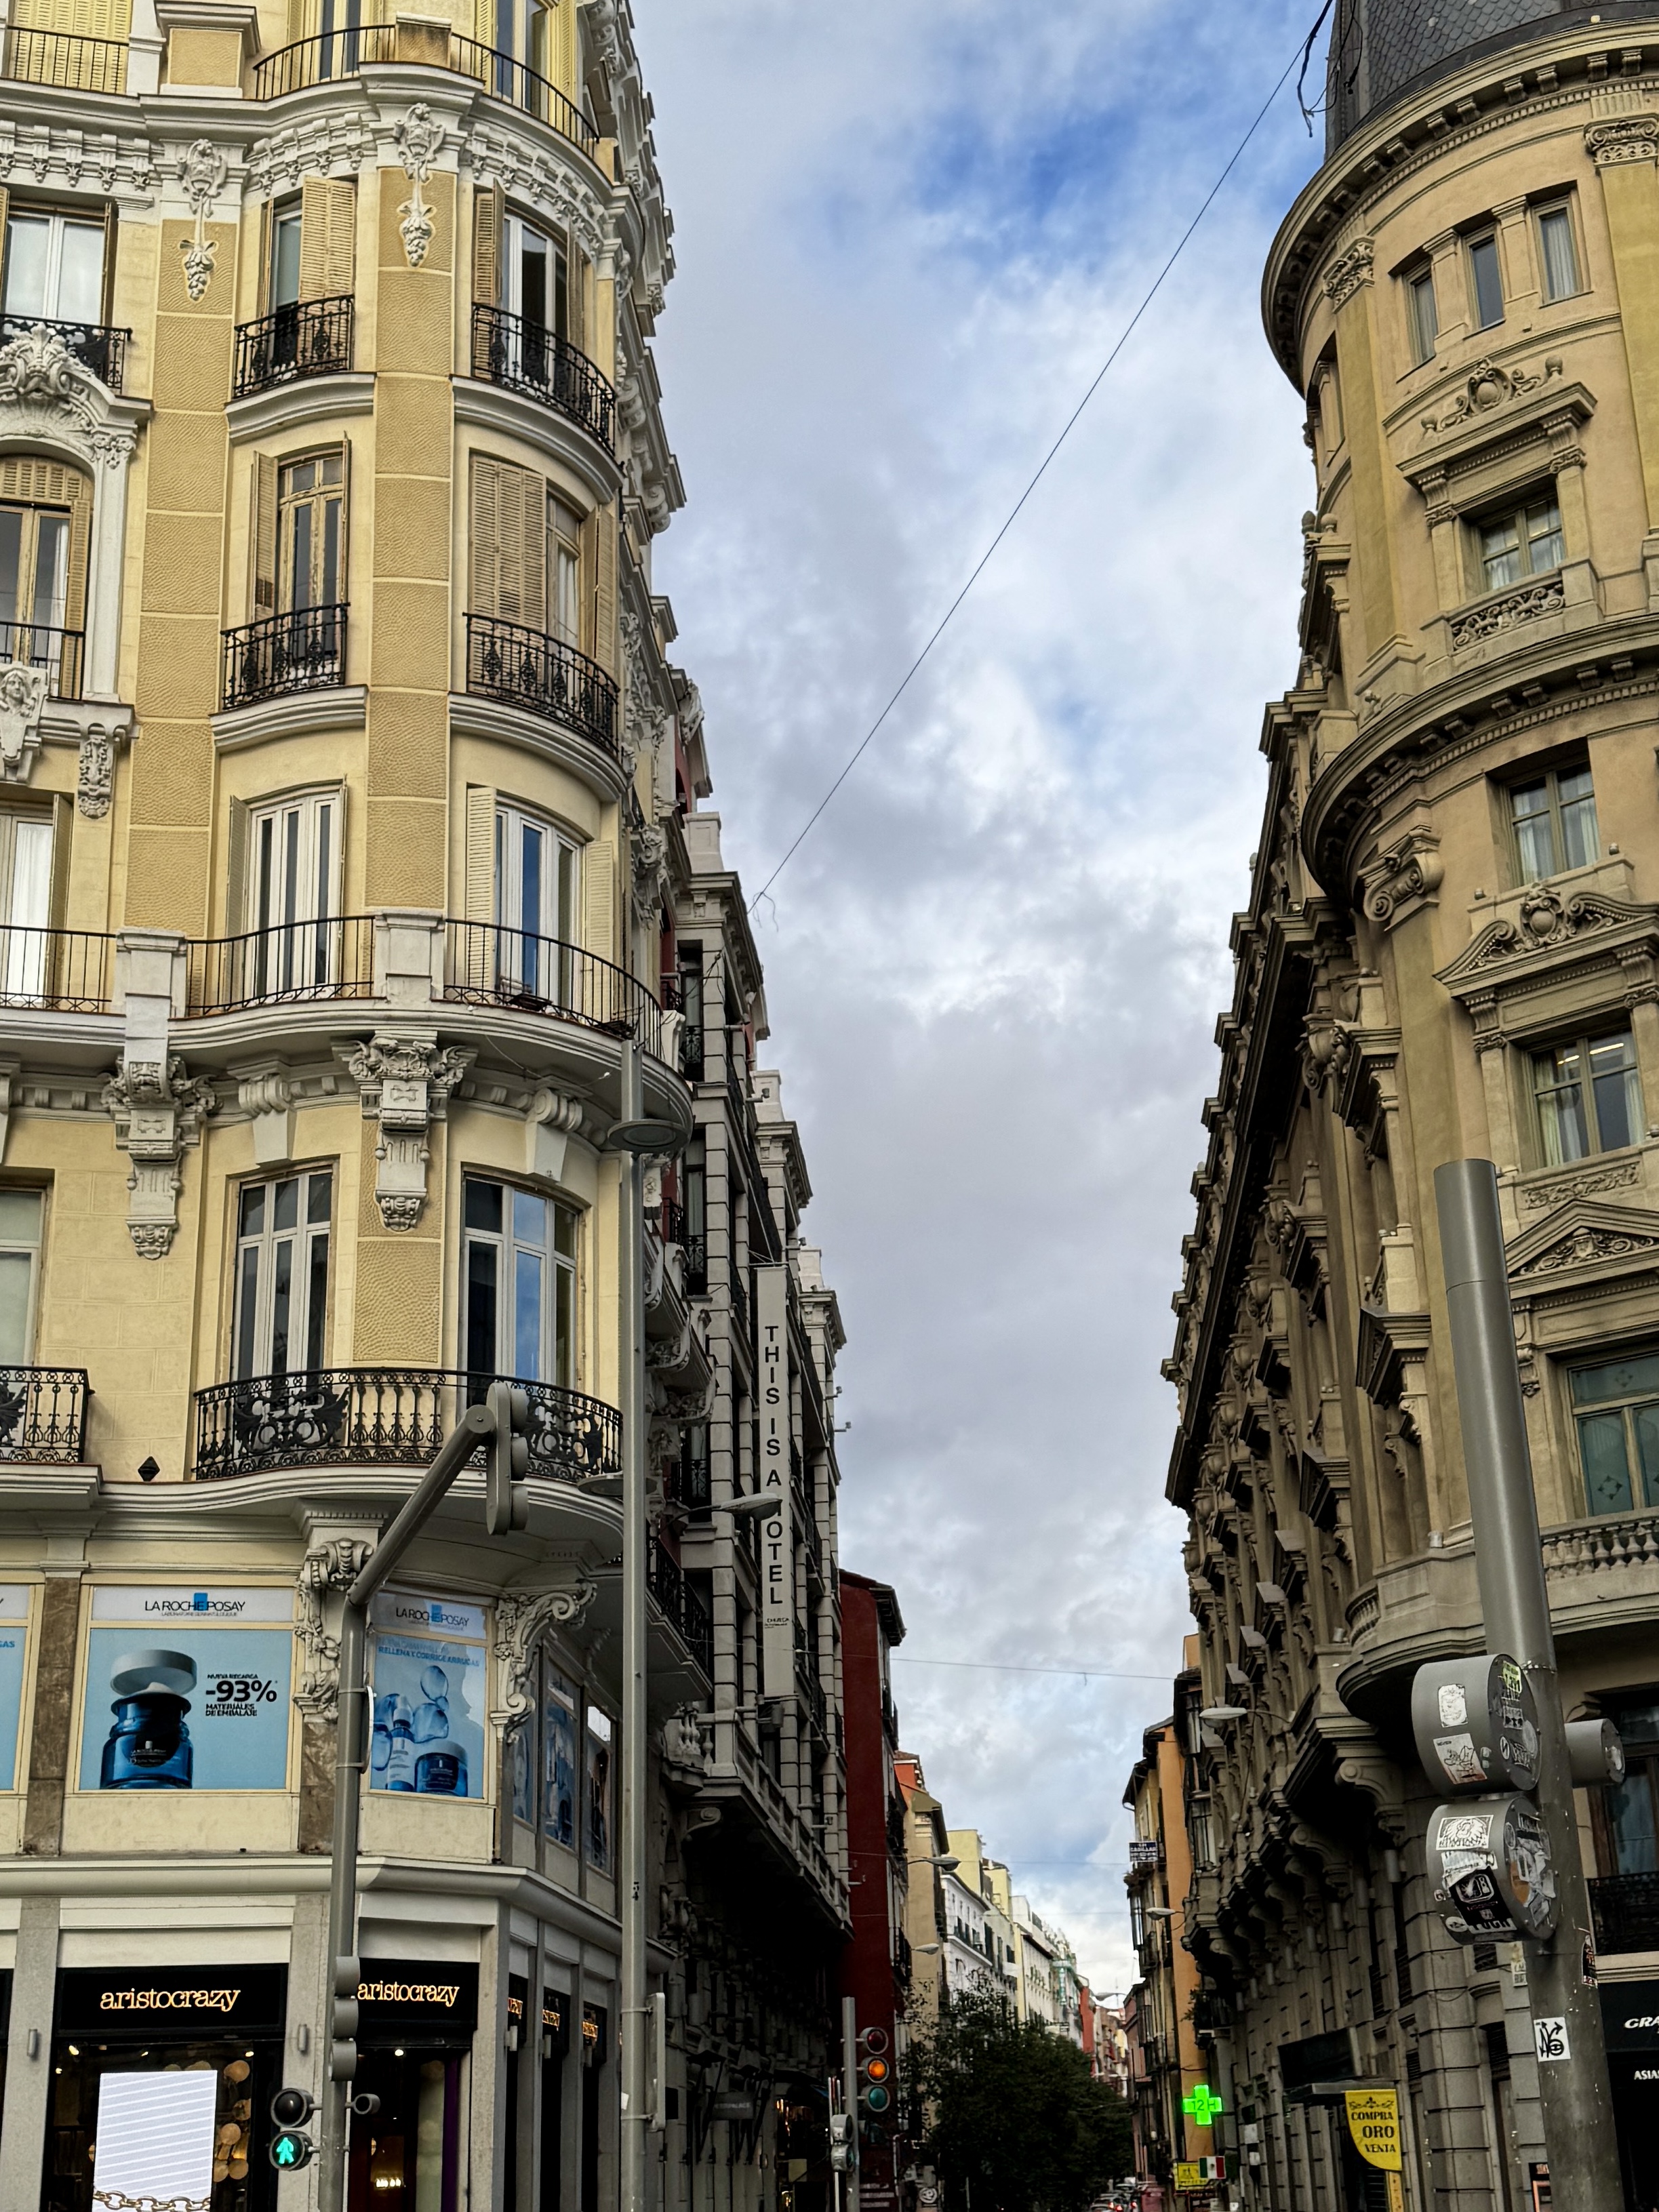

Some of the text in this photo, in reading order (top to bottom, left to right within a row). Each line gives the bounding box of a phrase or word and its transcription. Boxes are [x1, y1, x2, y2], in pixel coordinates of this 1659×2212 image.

[765, 1325, 780, 1405] THIS
[766, 1417, 780, 1456] IS
[766, 1469, 782, 1487] A
[766, 1500, 783, 1605] OTEL
[145, 1601, 161, 1611] LA
[206, 1601, 245, 1611] POSAY
[396, 1607, 407, 1618] LA
[441, 1613, 470, 1627] POSAY
[378, 1646, 410, 1657] RELLENA
[100, 1988, 241, 2012] aristocrazy
[357, 1979, 460, 2007] aristocrazy
[1634, 2070, 1659, 2080] ASIA
[1351, 2111, 1394, 2120] COMPRA
[1362, 2125, 1395, 2138] ORO
[1364, 2144, 1396, 2152] VENTA
